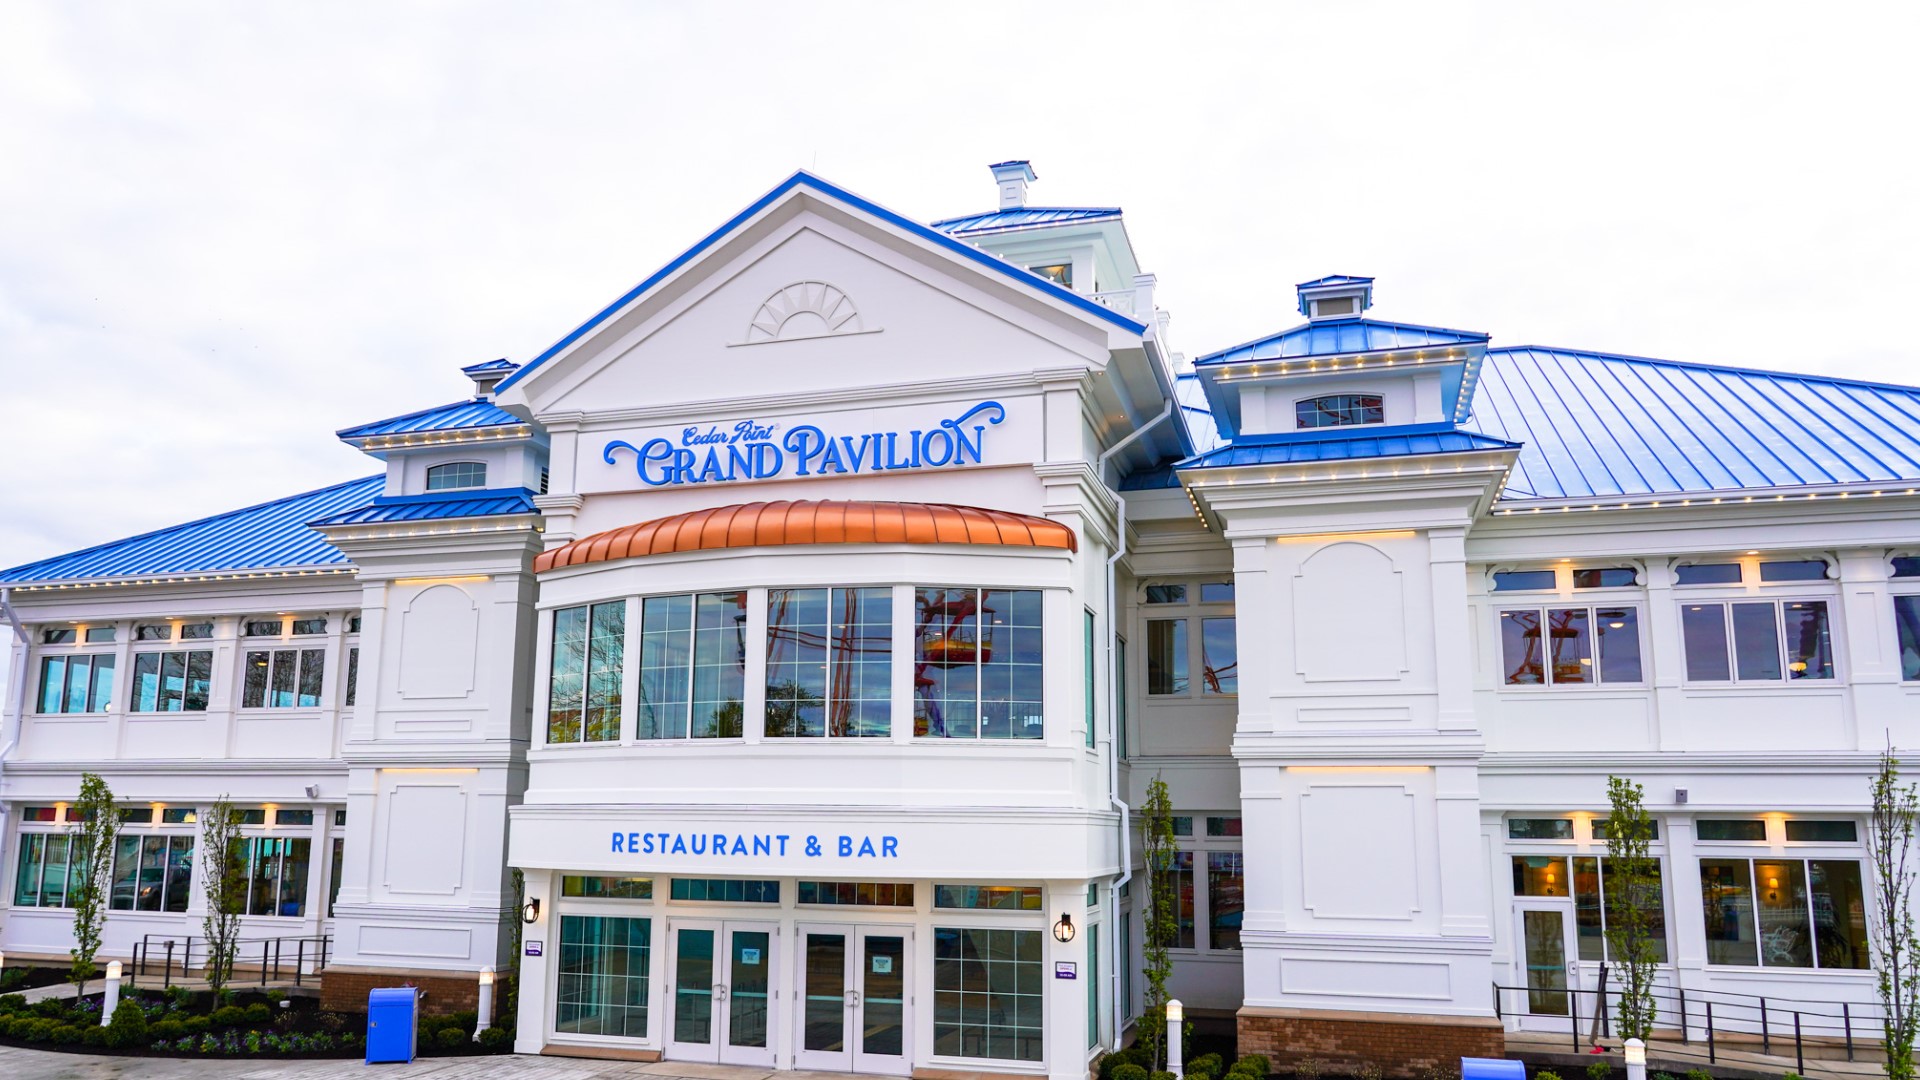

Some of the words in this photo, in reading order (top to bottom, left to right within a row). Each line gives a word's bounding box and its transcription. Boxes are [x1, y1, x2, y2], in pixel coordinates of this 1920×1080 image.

[603, 438, 783, 486] GRAND
[783, 401, 1006, 475] PAVILION
[682, 426, 728, 447] Cedar
[728, 420, 774, 445] Point
[612, 832, 790, 856] RESTAURANT
[805, 835, 822, 857] &
[838, 835, 898, 857] BAR
